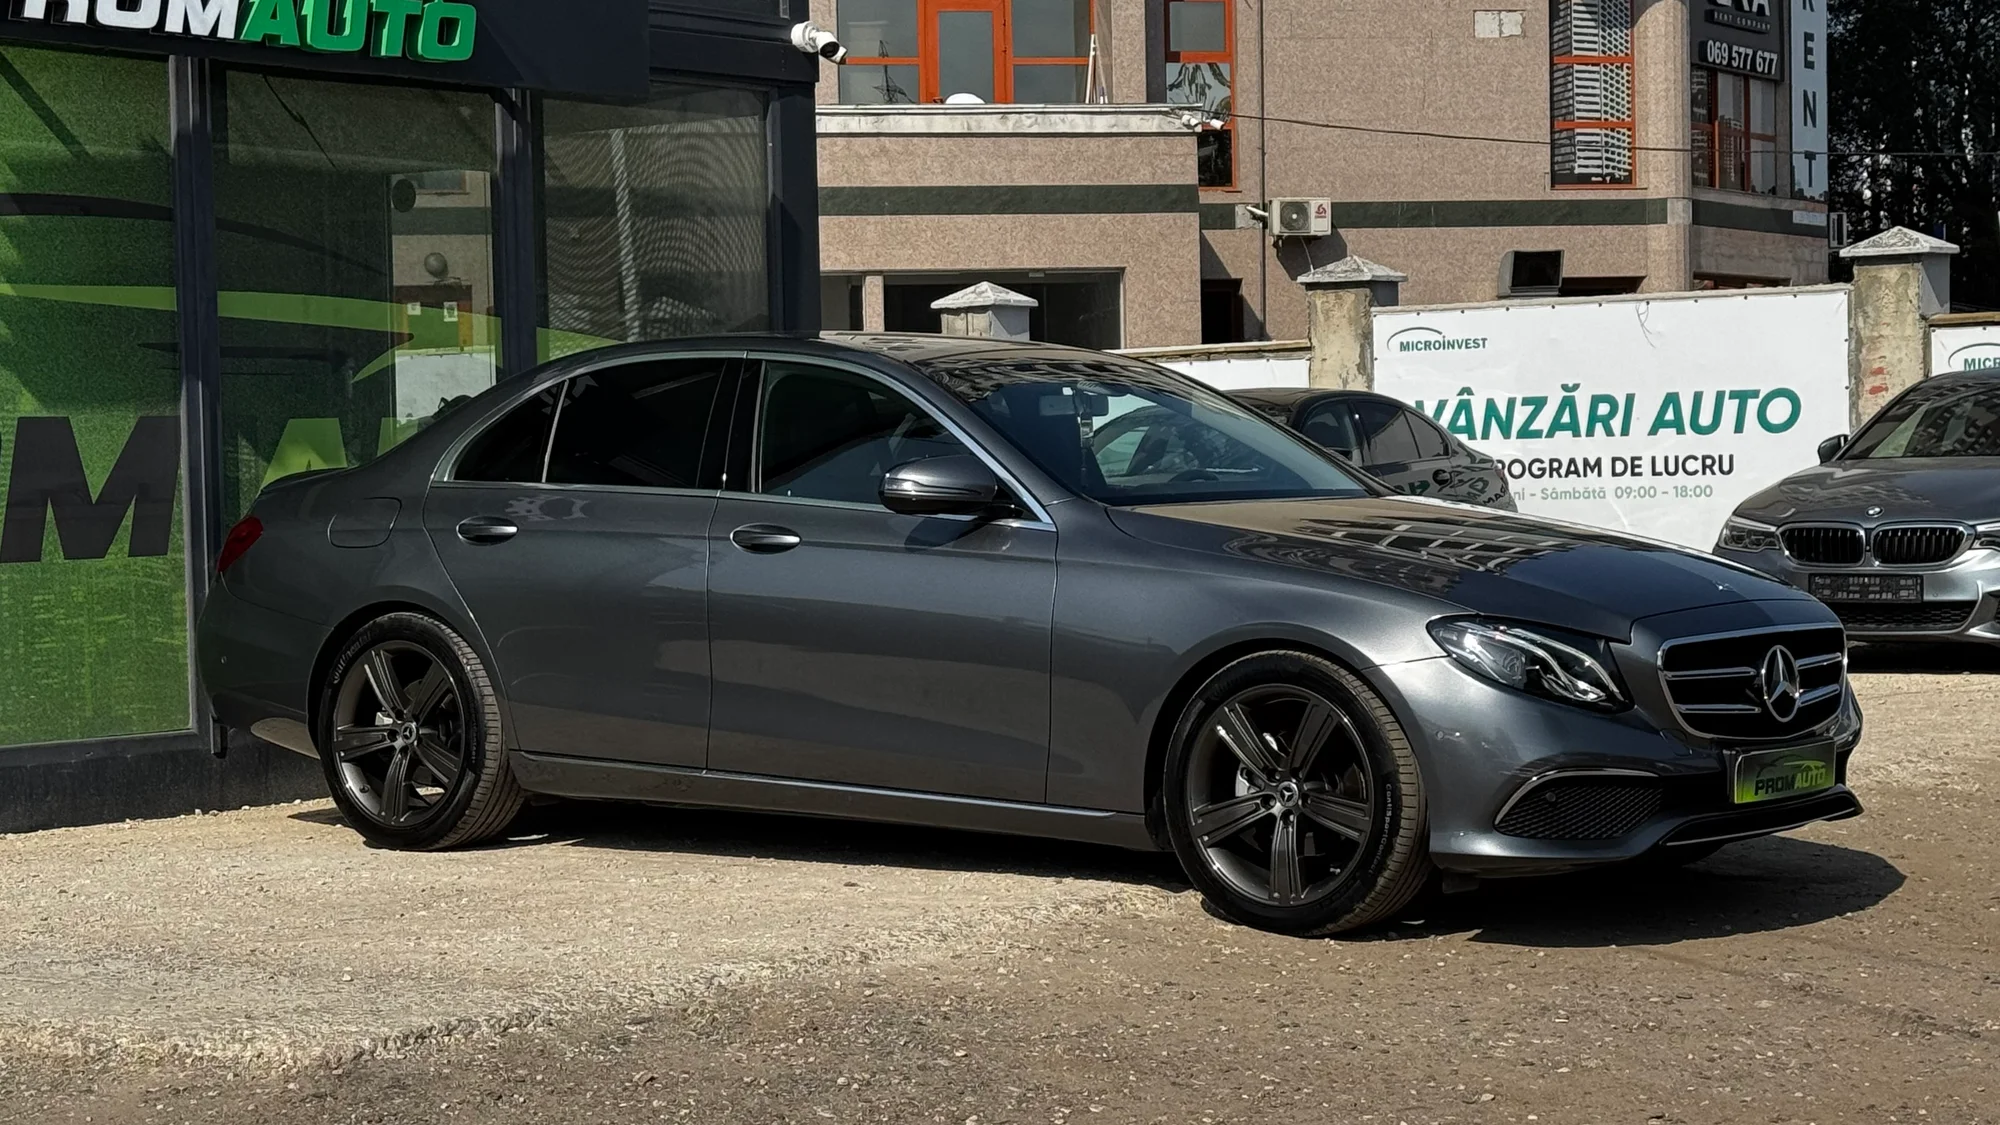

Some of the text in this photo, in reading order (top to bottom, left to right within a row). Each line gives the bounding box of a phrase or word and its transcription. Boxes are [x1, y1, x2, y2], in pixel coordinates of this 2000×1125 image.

[1707, 39, 1778, 75] 069 577 677
[1647, 387, 1802, 436] AUTO
[1611, 456, 1643, 477] DE
[1651, 454, 1734, 476] LUCRU
[1540, 486, 1607, 501] Sâmbătă
[1614, 485, 1657, 499] 09:00
[1672, 484, 1714, 498] 18:00
